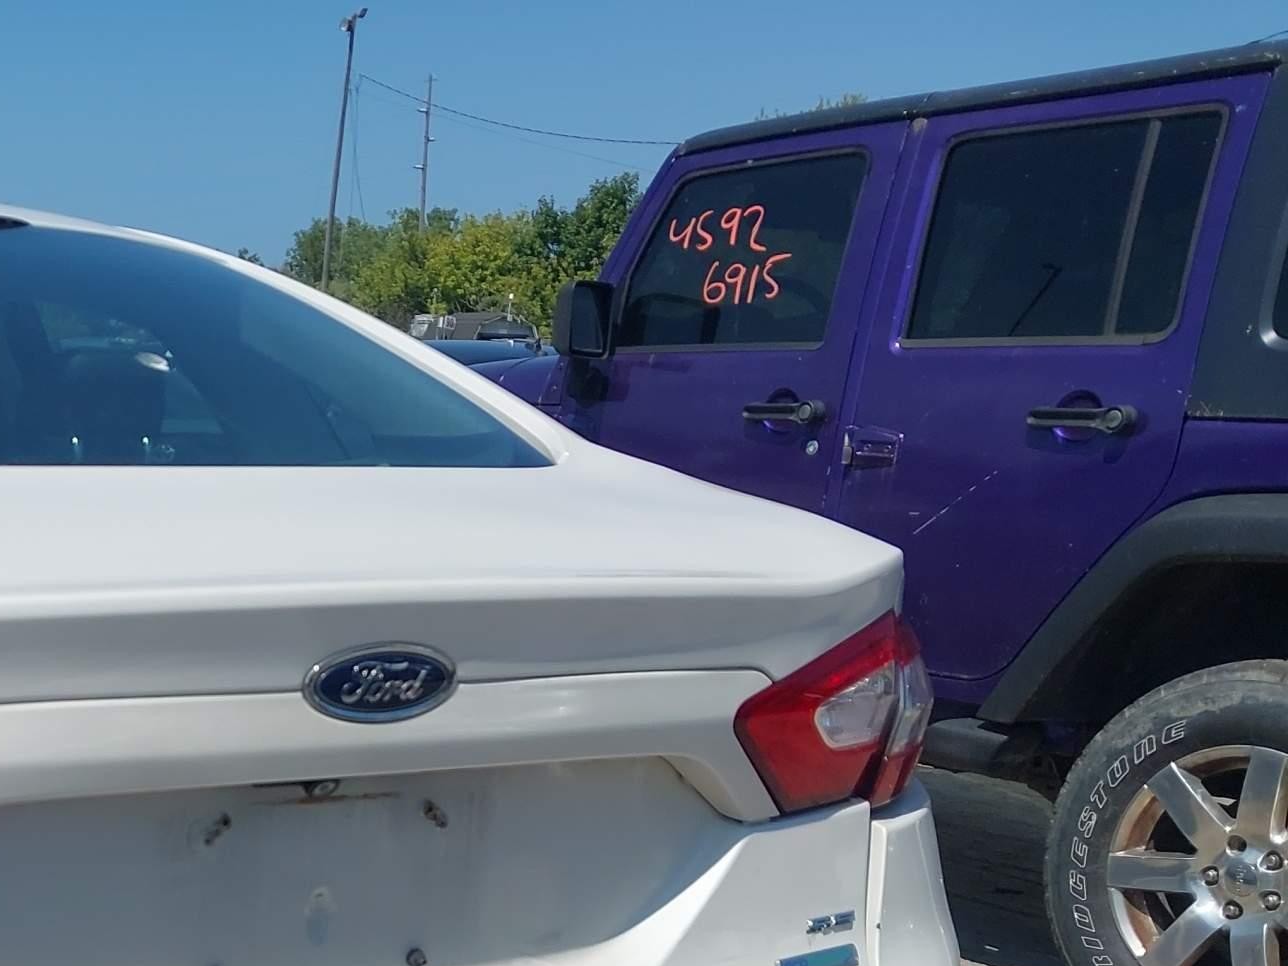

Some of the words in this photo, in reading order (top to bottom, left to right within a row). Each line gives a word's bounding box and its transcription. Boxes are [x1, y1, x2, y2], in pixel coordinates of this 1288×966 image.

[669, 205, 767, 251] 4592
[703, 253, 792, 305] 6915
[340, 660, 433, 705] Ford
